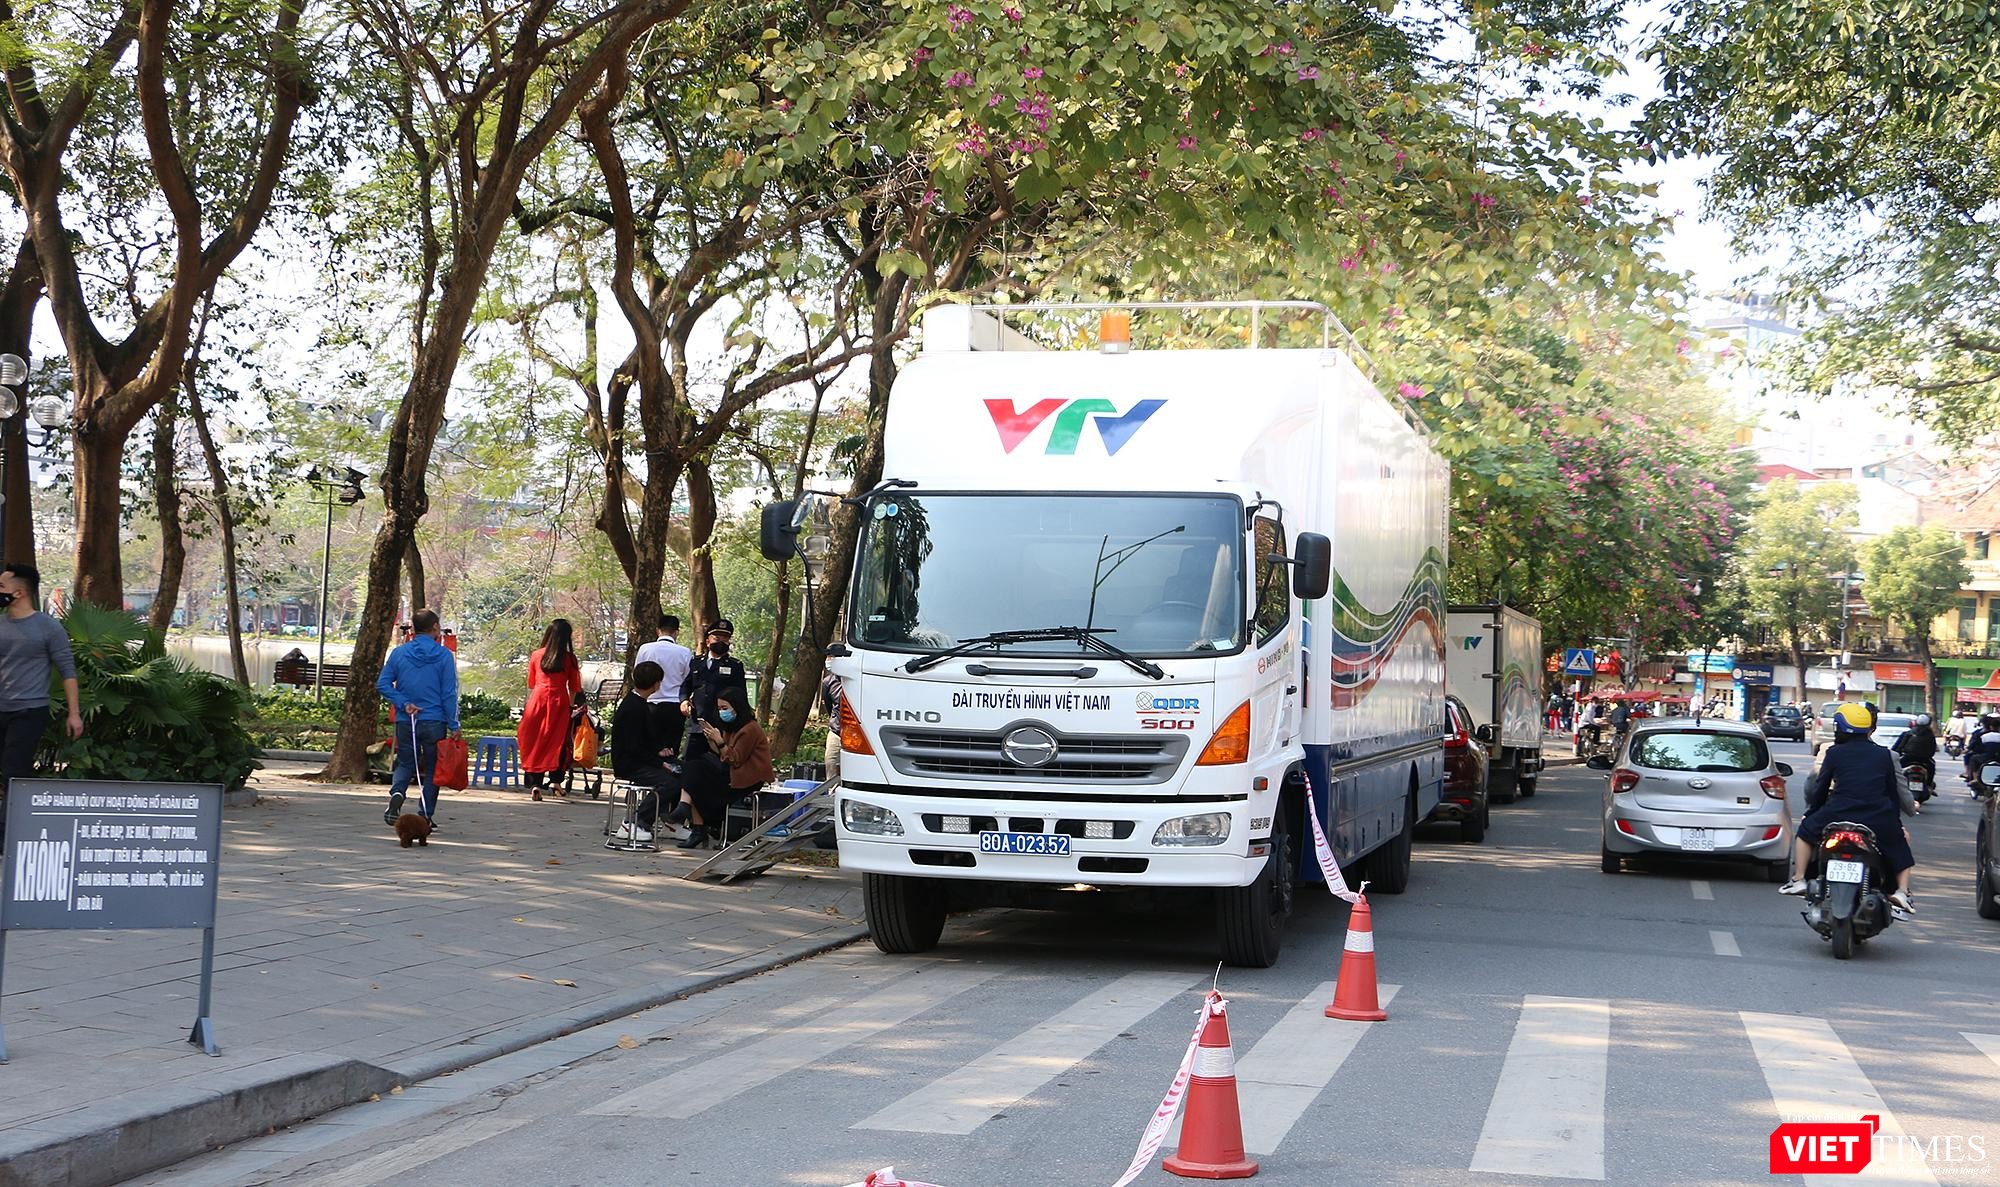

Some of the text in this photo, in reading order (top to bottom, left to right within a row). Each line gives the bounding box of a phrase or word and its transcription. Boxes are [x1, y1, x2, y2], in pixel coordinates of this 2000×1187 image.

[982, 398, 1168, 456] VTV
[1449, 636, 1483, 650] VTV
[952, 688, 1110, 712] ĐÀI TRUYỀN HÌNH VIỆT NAM
[1153, 698, 1199, 710] QDR
[876, 709, 942, 723] HINO
[1141, 719, 1195, 730] 500
[31, 791, 53, 806] CHẤP
[53, 792, 74, 807] HÀNH
[75, 793, 89, 810] NỘI
[89, 796, 106, 808] QUY
[106, 796, 126, 811] HOẠT
[127, 794, 148, 811] ĐỘNG
[160, 795, 181, 809] HOÀN
[981, 833, 1068, 854] 80A-023.52
[13, 828, 71, 901] KHÔNG
